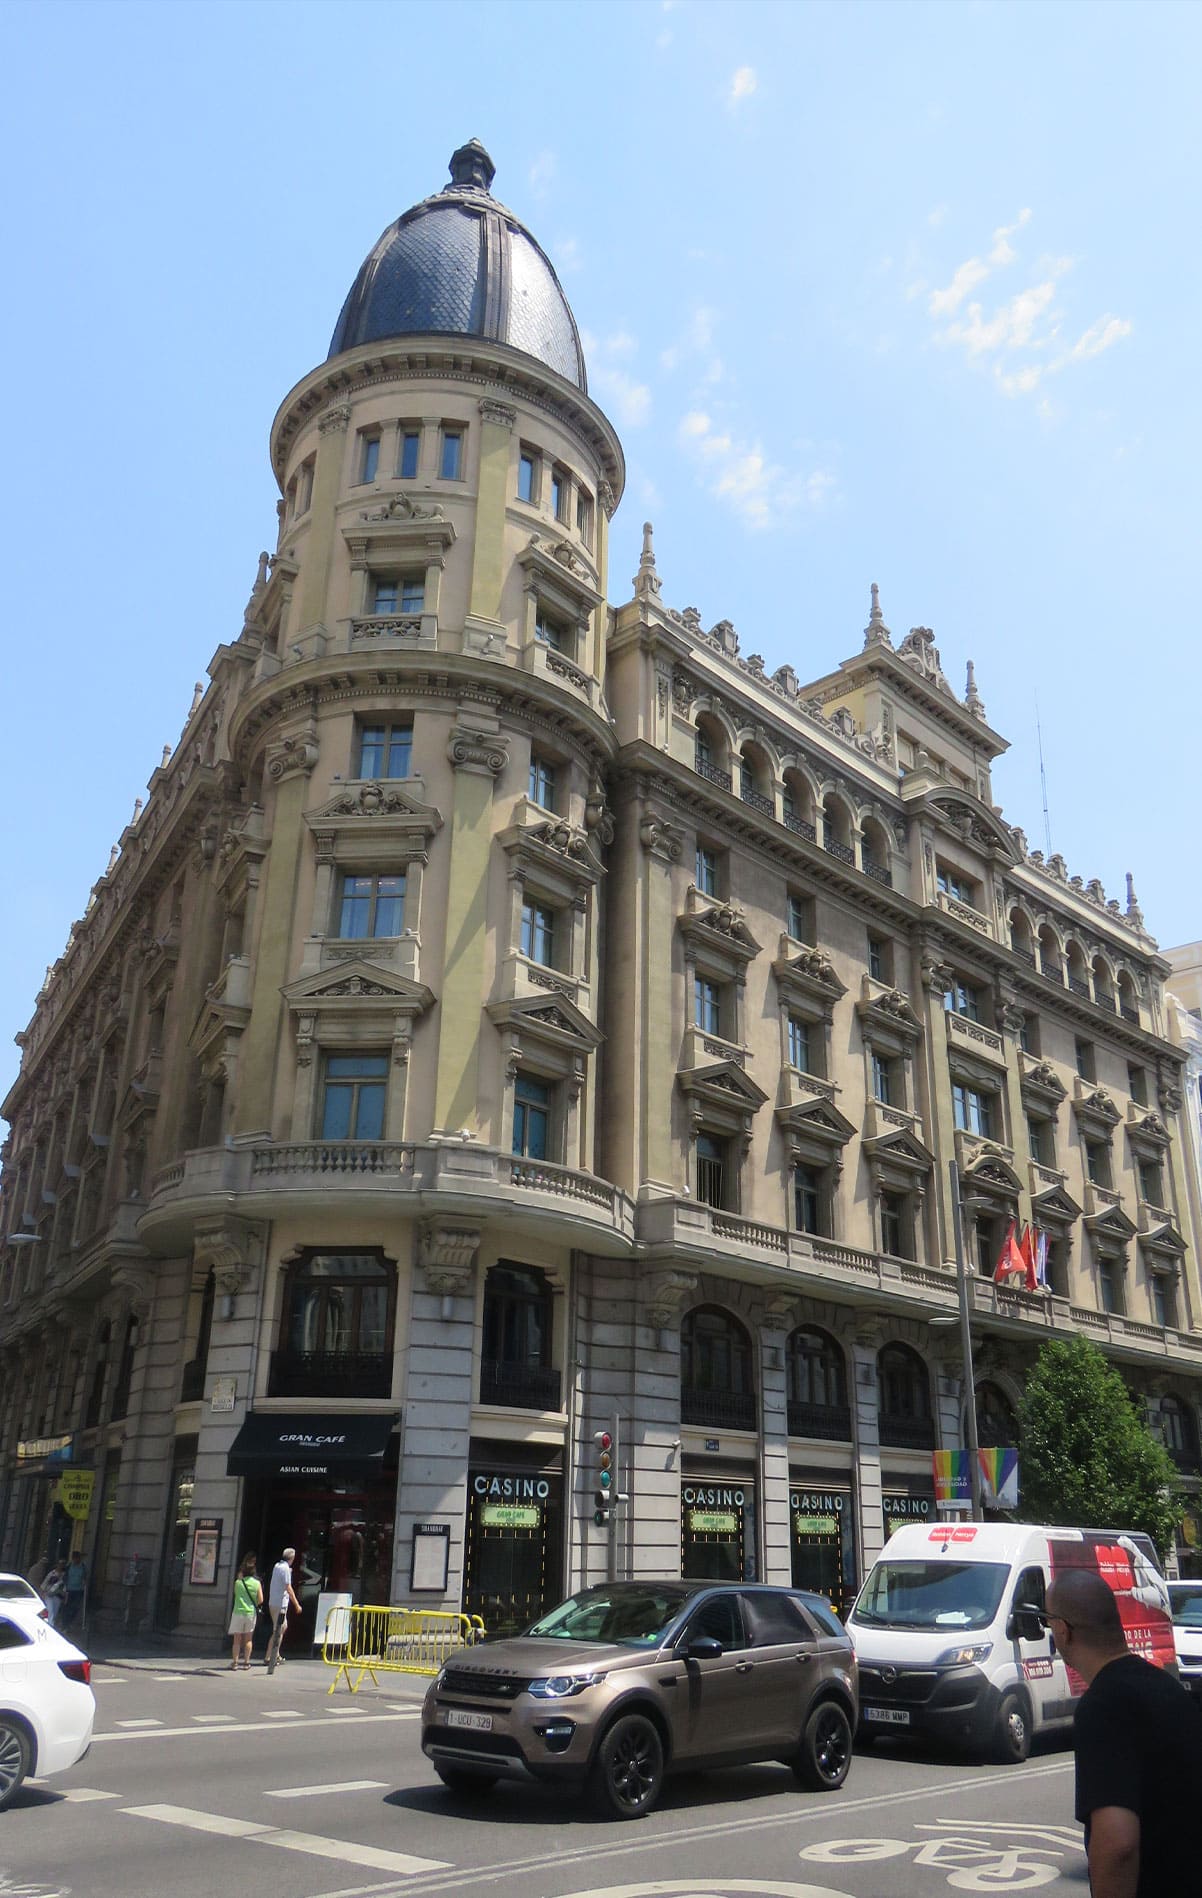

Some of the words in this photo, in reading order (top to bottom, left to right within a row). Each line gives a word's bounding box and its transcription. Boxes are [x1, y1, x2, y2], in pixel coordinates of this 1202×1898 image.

[301, 1466, 328, 1474] CUISINE
[474, 1476, 549, 1498] CASINO
[684, 1487, 745, 1506] CASINO
[883, 1498, 929, 1513] CASINO
[1134, 1630, 1142, 1639] DE
[1143, 1629, 1151, 1638] LA
[455, 1664, 519, 1675] DISCOVERY
